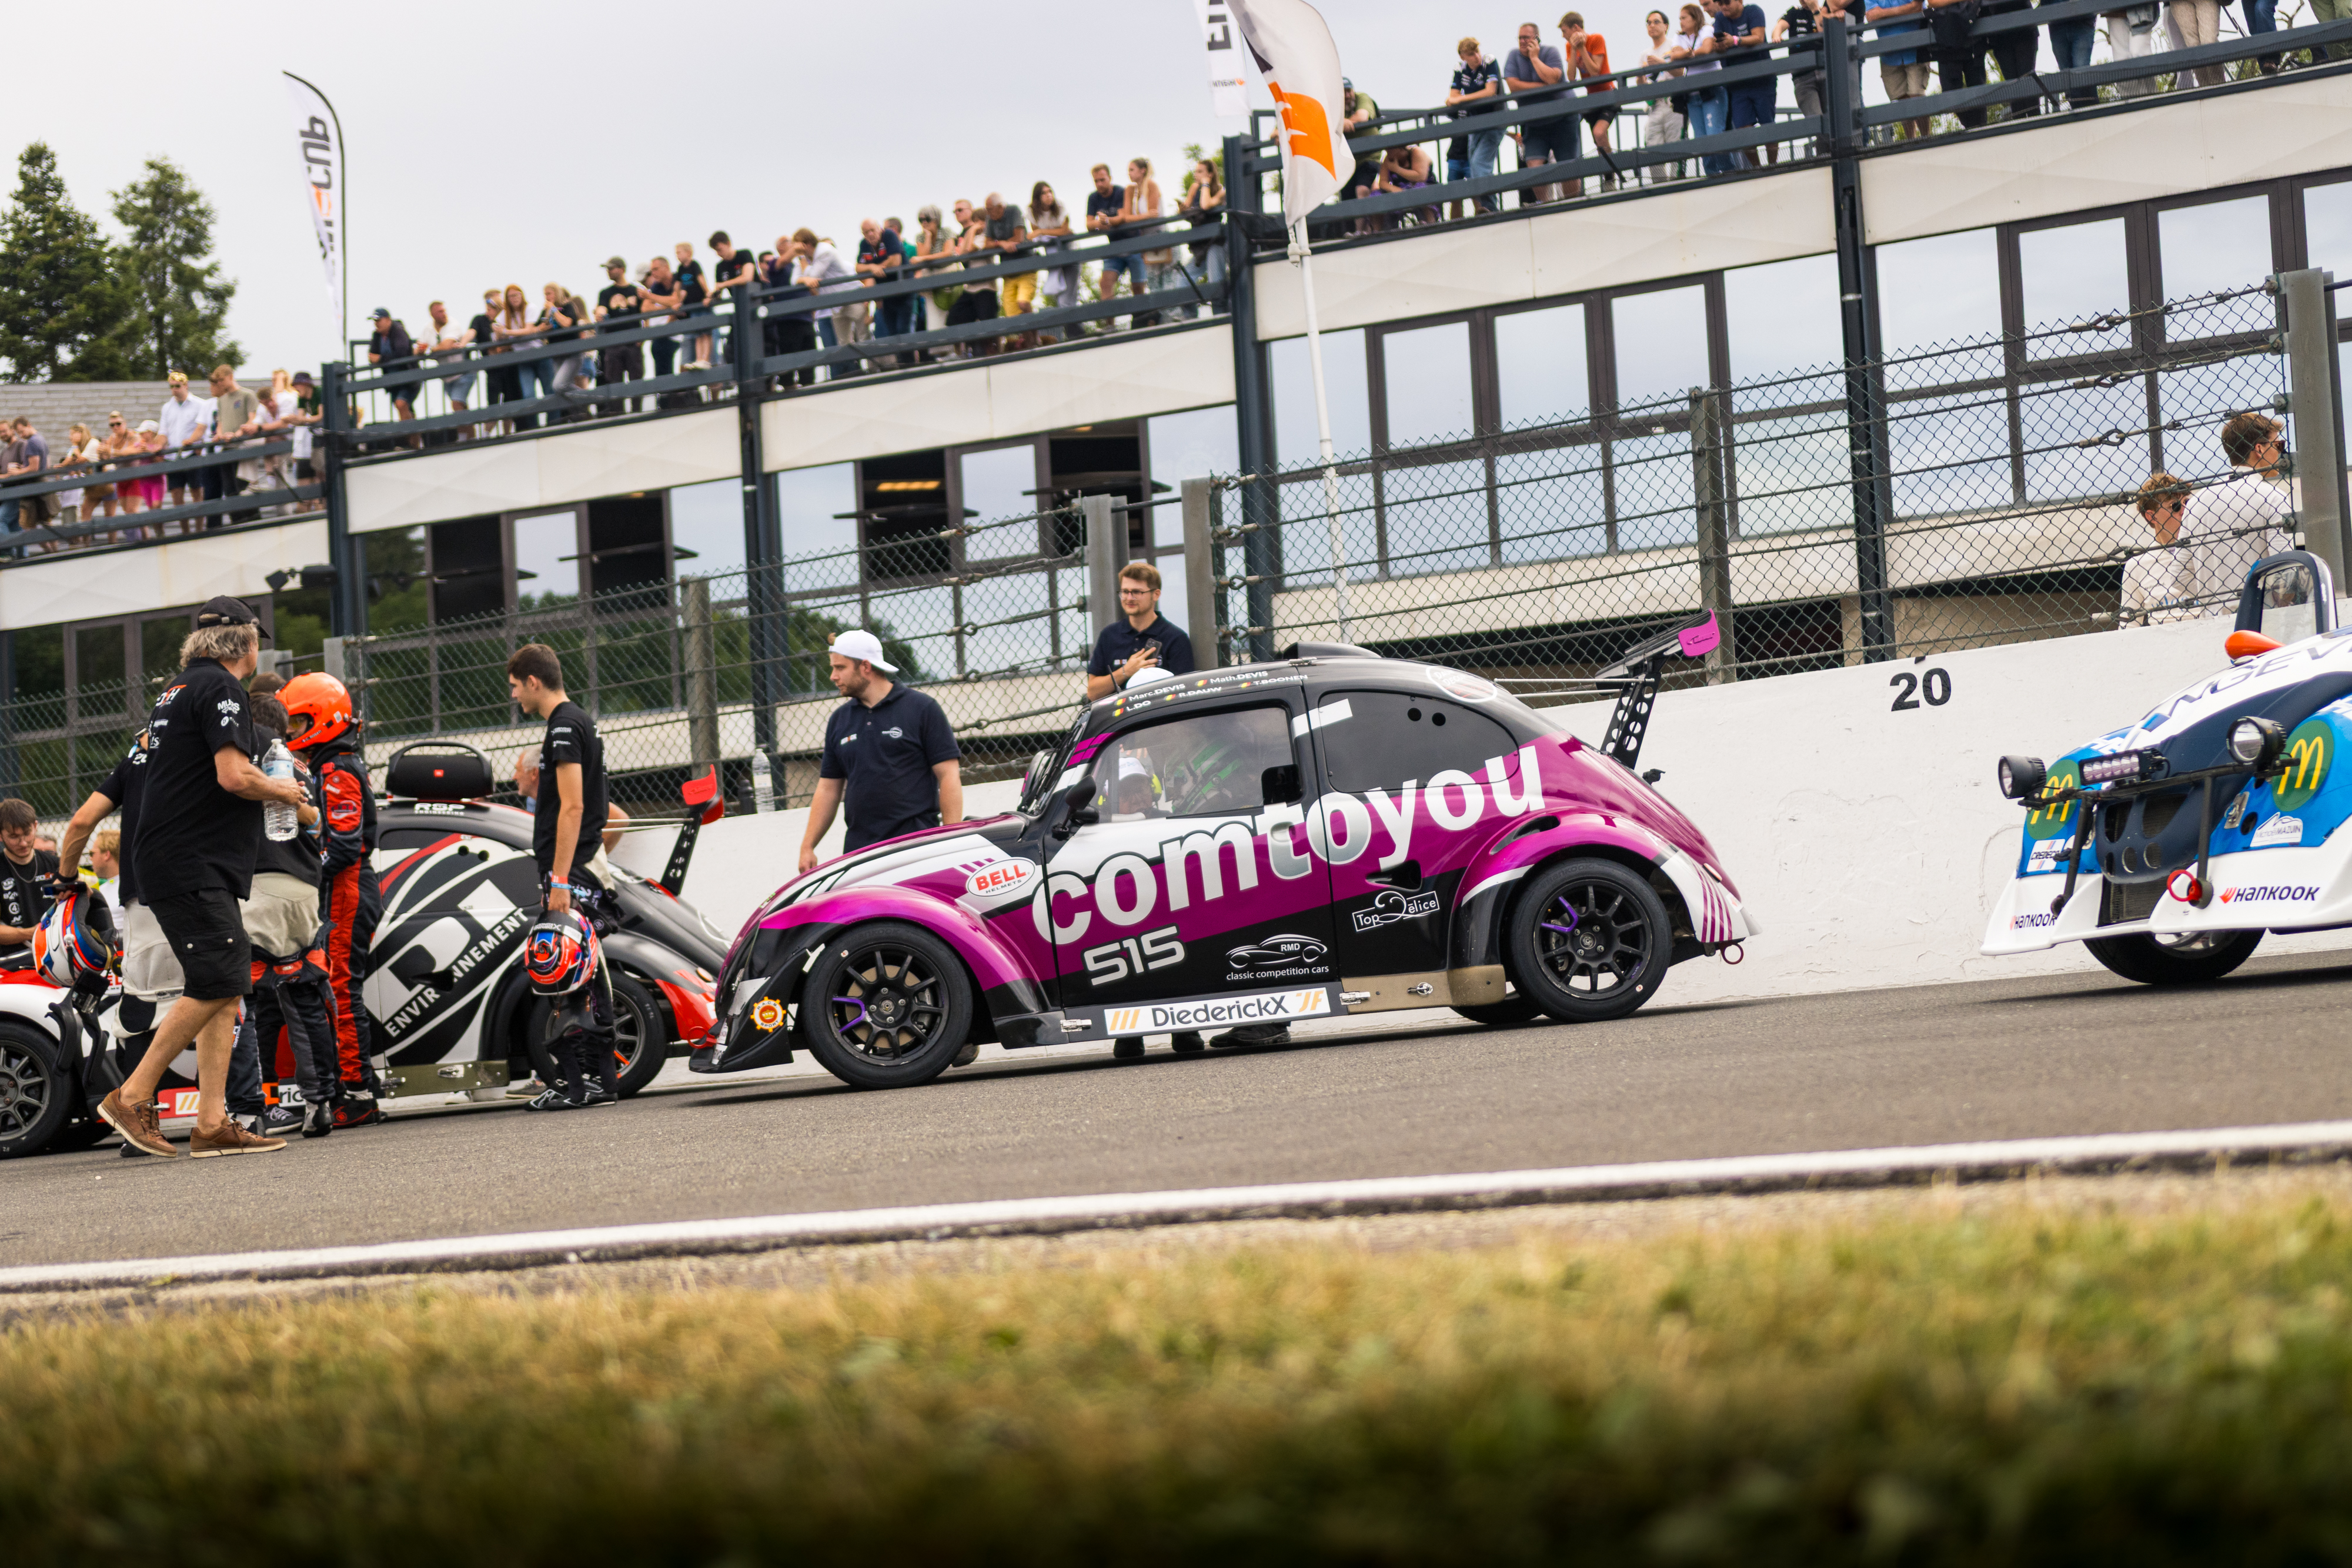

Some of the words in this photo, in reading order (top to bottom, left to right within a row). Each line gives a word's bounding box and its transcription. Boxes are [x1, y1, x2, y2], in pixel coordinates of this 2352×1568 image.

[1210, 670, 1268, 684] Math.DEVIS
[1253, 674, 1308, 686] T.BOONEN
[1128, 683, 1186, 702] Marc.DEVIS
[1178, 687, 1222, 698] R.DAUW
[1889, 667, 1952, 712] 20
[1126, 700, 1151, 712] L.DO
[414, 803, 466, 811] RSP
[1032, 745, 1546, 945] comtoyou
[975, 864, 1027, 891] BELL
[985, 880, 1022, 894] HELMETS
[1356, 914, 1379, 926] Top
[1280, 942, 1301, 952] RMD
[1083, 925, 1185, 986] 515
[384, 907, 529, 1038] ENVIRNNEMENT
[1226, 971, 1254, 981] classic
[1256, 967, 1310, 979] competition
[1151, 995, 1291, 1028] DiederickX
[760, 1019, 780, 1028] SPORT
